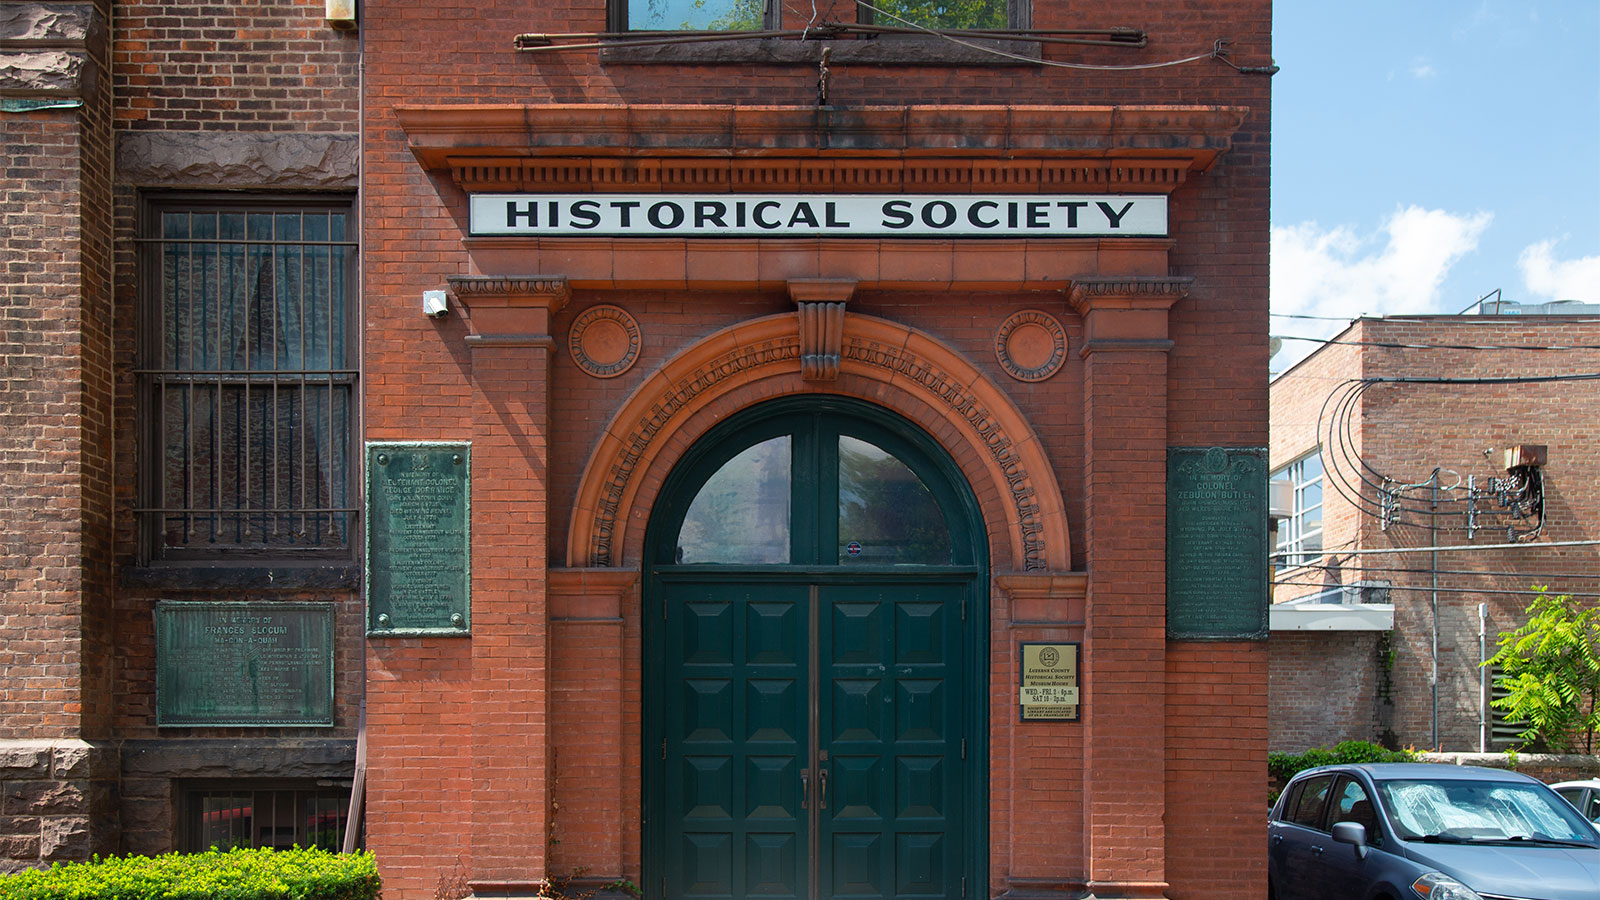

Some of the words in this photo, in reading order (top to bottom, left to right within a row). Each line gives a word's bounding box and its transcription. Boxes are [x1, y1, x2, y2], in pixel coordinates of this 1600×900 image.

[506, 200, 850, 229] HISTORICAL
[881, 200, 1135, 229] SOCIETY
[1196, 482, 1235, 490] COLONEL
[1178, 491, 1217, 499] ZEBULON
[263, 616, 272, 624] OF
[205, 626, 245, 634] FRANCES
[251, 626, 287, 634] SLOCUM
